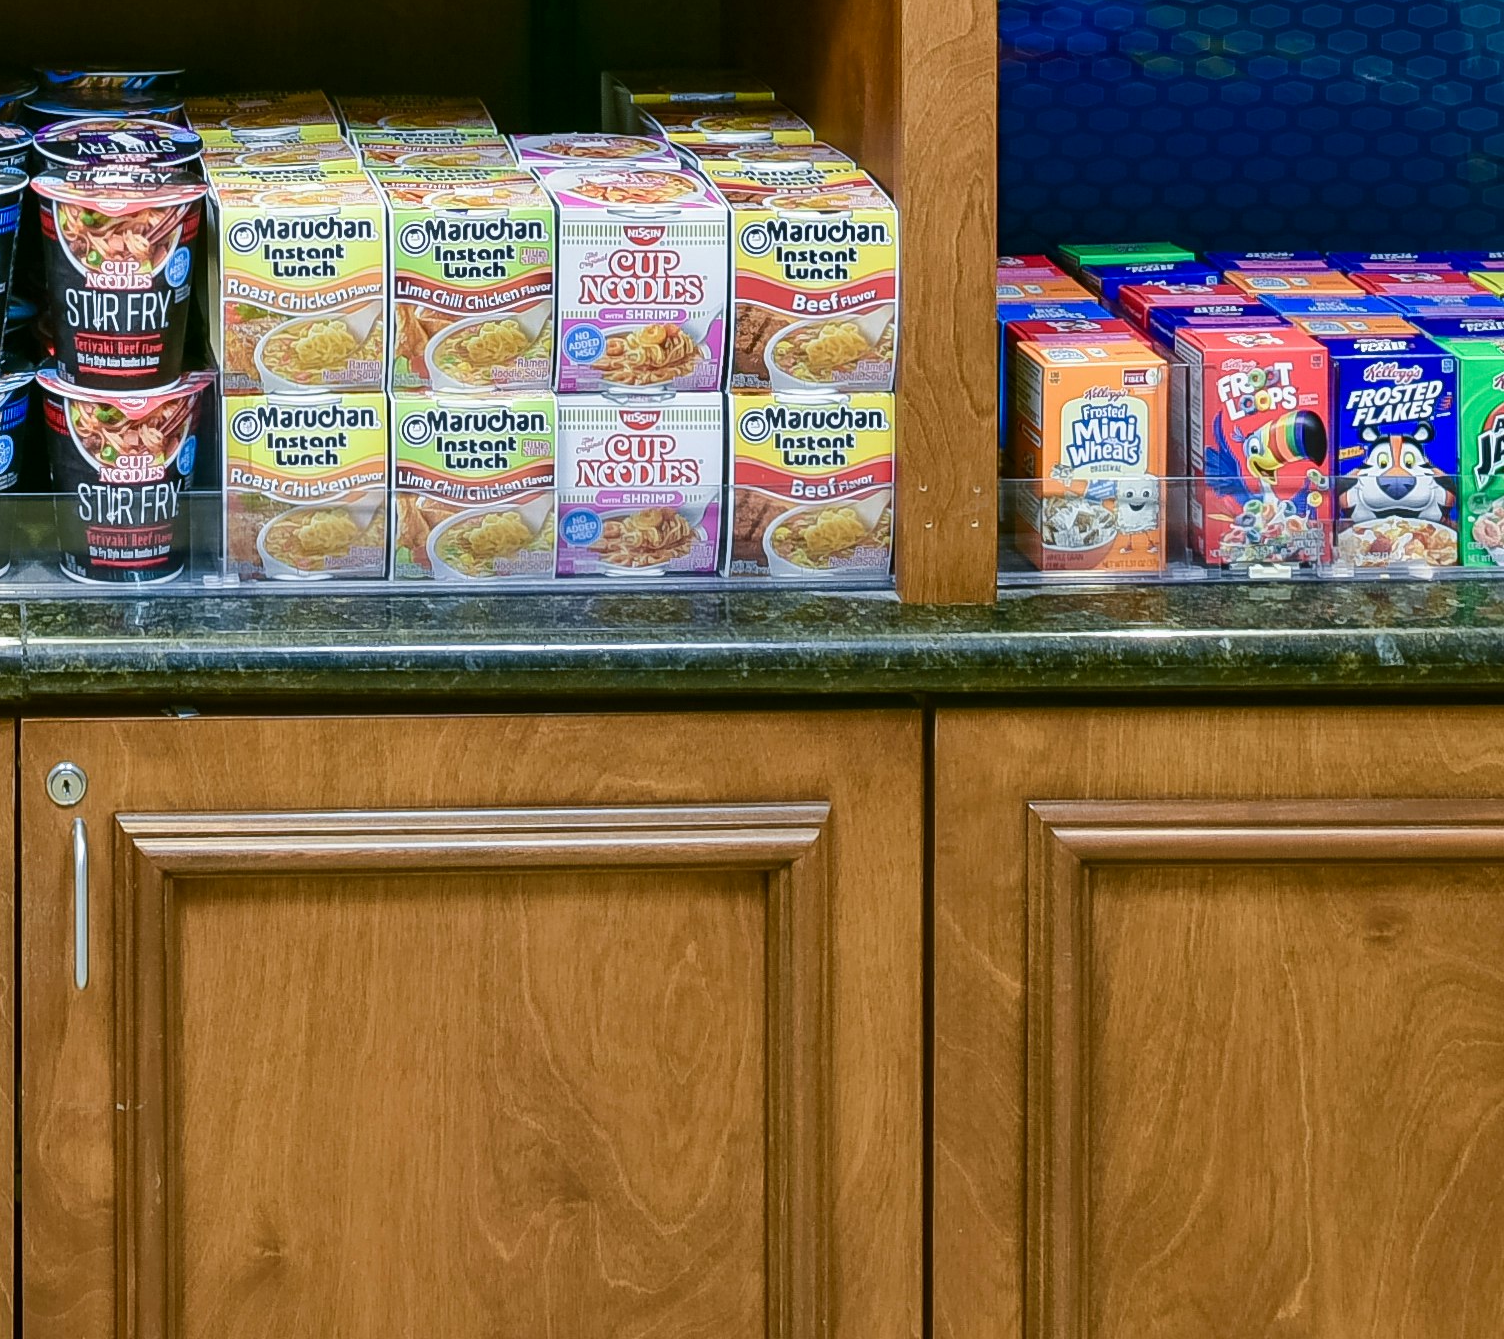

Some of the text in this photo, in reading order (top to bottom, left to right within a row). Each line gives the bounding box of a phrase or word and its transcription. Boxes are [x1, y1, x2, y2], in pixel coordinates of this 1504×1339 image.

[254, 218, 379, 242] Maruchan
[627, 228, 662, 240] NISSIN
[263, 244, 344, 263] Instant
[608, 248, 679, 280] CUP
[273, 261, 337, 279] Lunch
[226, 280, 381, 309] Roast Chicken Flavor
[396, 281, 465, 305] Lime Chili
[580, 274, 705, 305] NOODLES
[793, 288, 877, 312] Beef Flavor
[625, 309, 679, 321] SHRIMP
[568, 339, 601, 353] ADDED
[1364, 363, 1422, 382] Kellogg's
[1345, 381, 1443, 410] FROSTED
[1081, 403, 1129, 419] Frosted
[1352, 402, 1435, 425] FLAKES
[1074, 417, 1135, 446] Mini
[1067, 441, 1138, 468] Wheats
